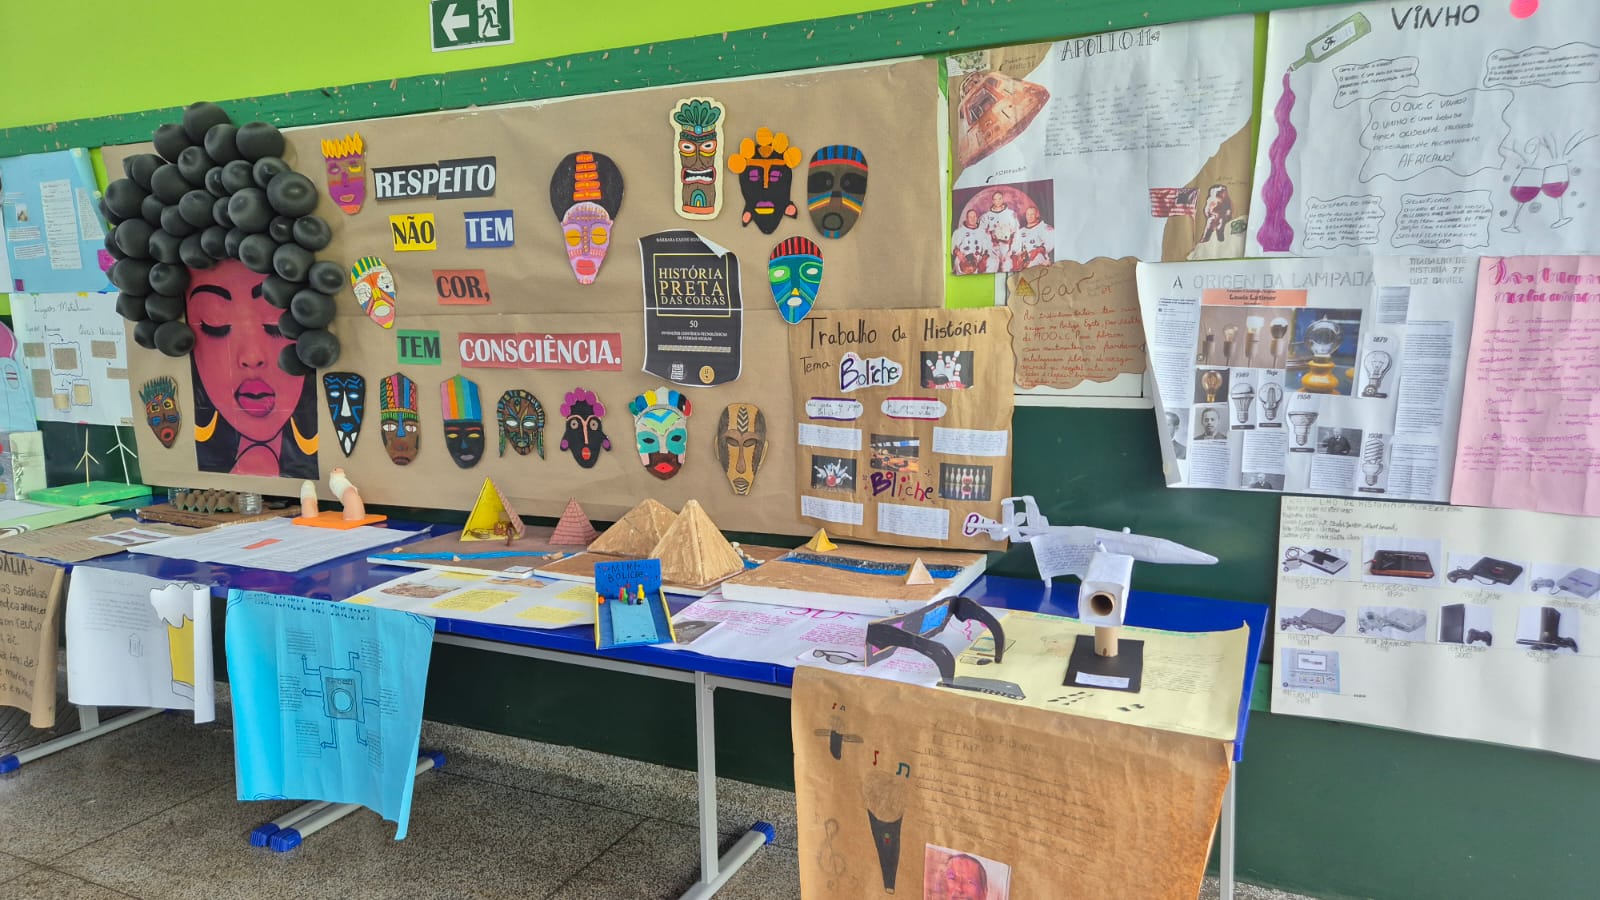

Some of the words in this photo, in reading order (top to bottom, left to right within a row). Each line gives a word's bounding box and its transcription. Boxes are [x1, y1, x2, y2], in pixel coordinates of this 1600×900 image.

[1391, 4, 1480, 31] VINHO
[1060, 31, 1134, 61] APOLLO
[1391, 101, 1400, 113] O
[1383, 117, 1408, 129] VINHO
[375, 163, 496, 199] RESPEITO
[391, 215, 436, 246] NÃO
[466, 217, 514, 244] TEM
[659, 265, 724, 280] HISTÓRIA
[1172, 275, 1183, 290] A
[436, 274, 491, 302] COR,
[660, 280, 725, 297] PRETA
[661, 296, 683, 305] DAS
[685, 296, 726, 306] COISAS
[689, 320, 699, 329] 50
[802, 316, 877, 350] Trabalho
[399, 336, 440, 359] TEM
[459, 333, 622, 366] CONSCIÊNCIA.
[840, 357, 900, 391] Boliche
